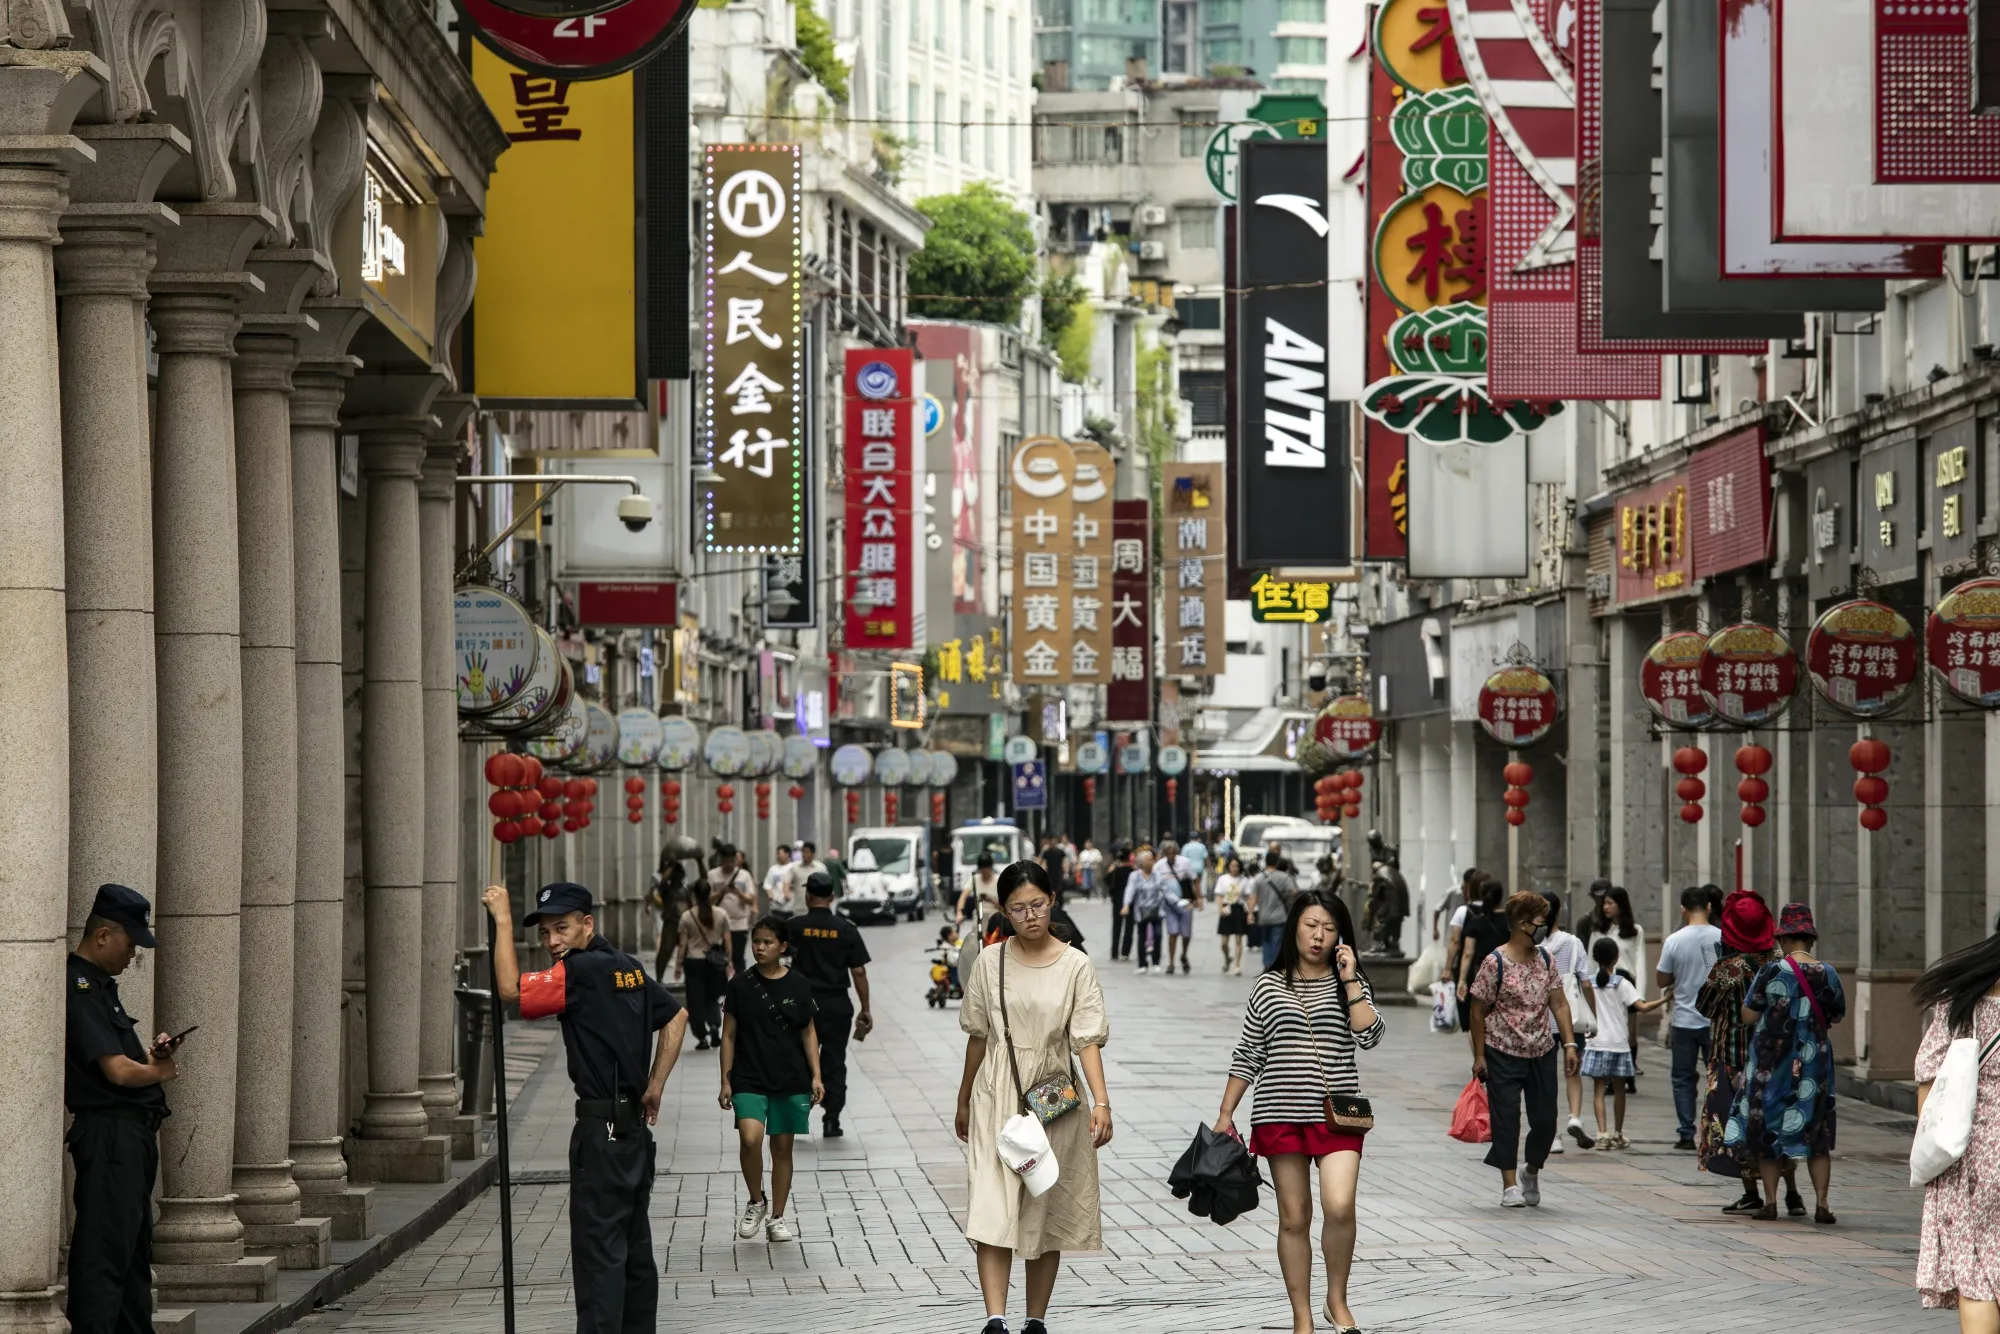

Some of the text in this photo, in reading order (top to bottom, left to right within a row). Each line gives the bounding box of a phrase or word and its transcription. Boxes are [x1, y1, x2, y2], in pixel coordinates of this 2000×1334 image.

[553, 15, 607, 38] 2F
[507, 72, 582, 142] 皇
[717, 250, 790, 478] 人民金行
[1264, 316, 1326, 468] ANTA
[1023, 508, 1060, 677] 中国黄金
[1072, 512, 1100, 676] 中国黄金
[1112, 538, 1145, 681] 周大福
[1251, 573, 1331, 610] 住宿
[1716, 662, 1780, 677] 岭南明珠
[1829, 643, 1898, 661] 岭南明珠
[1829, 659, 1898, 679] 活力荔湾
[1717, 677, 1780, 692] 活力荔湾
[614, 968, 645, 989] 荔安保
